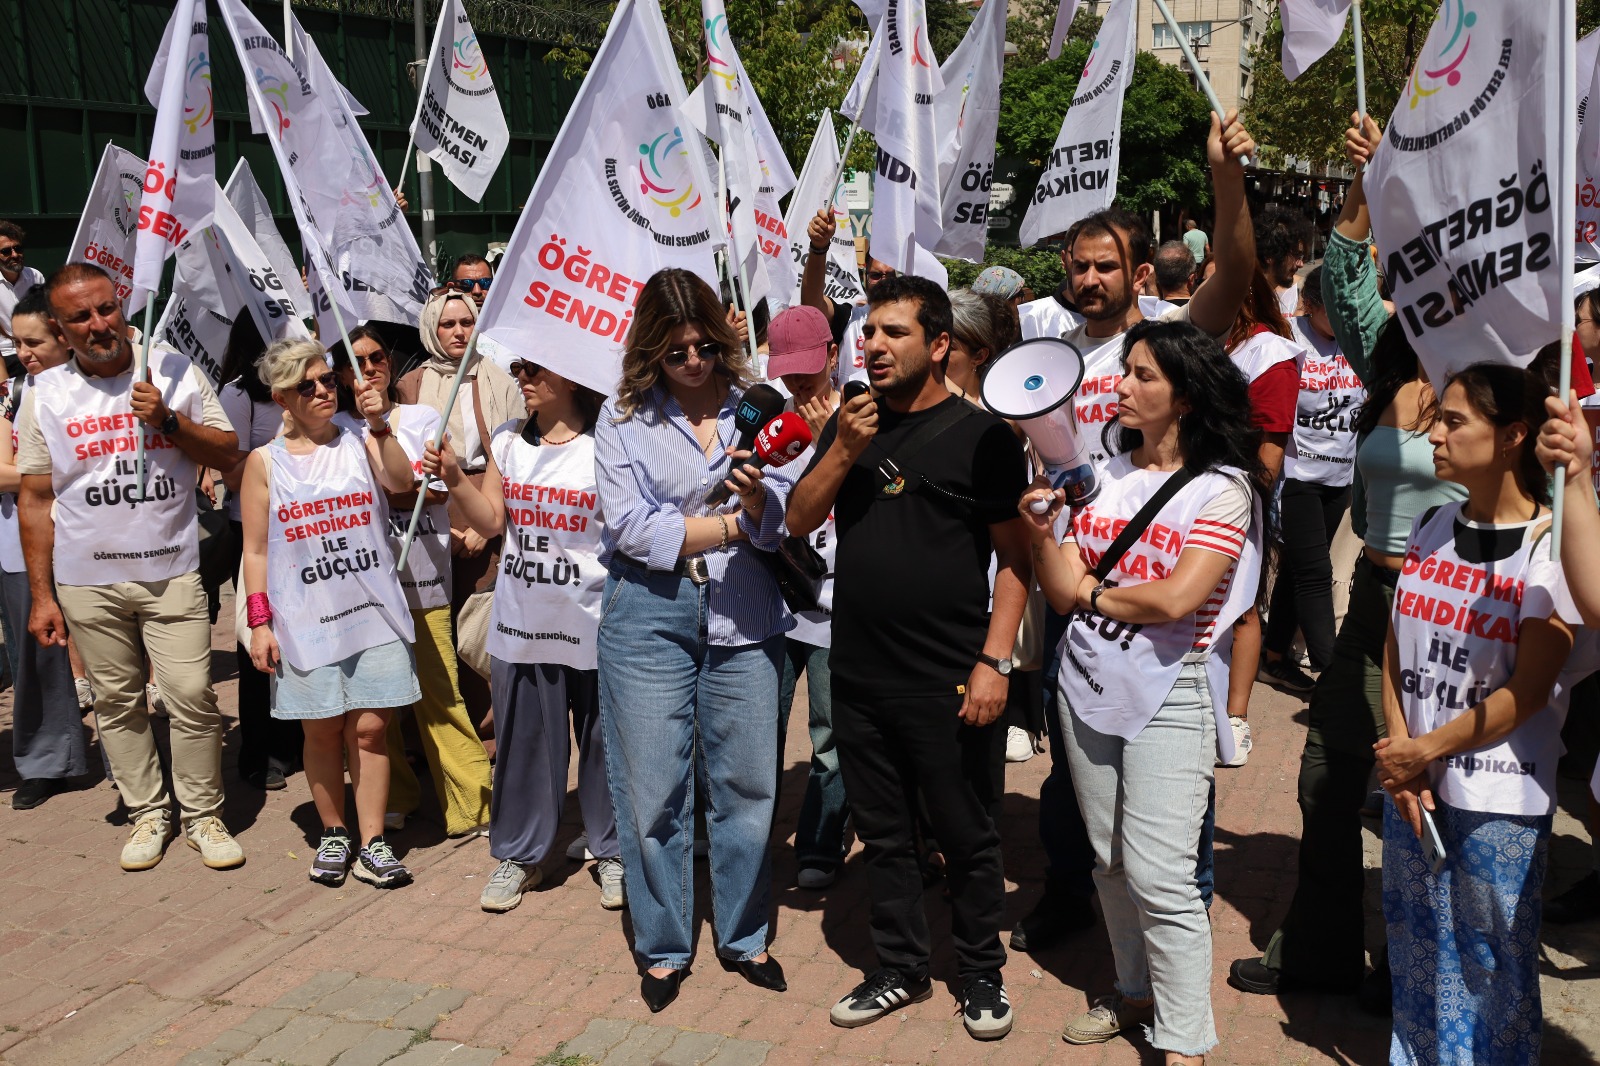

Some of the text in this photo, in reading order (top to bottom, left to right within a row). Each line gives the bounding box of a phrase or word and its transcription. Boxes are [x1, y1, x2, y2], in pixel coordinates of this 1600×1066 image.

[605, 158, 617, 179] ÖZEL
[607, 179, 631, 214] SEKTÖR
[524, 281, 634, 346] SENDİ
[277, 491, 374, 524] ÖĞRETMEN
[284, 510, 371, 543] SENDİKASI
[518, 527, 550, 553] İLE
[93, 544, 181, 561] ÖĞRETMEN SENDİKASI
[320, 536, 349, 554] İLE
[301, 547, 380, 585] GÜÇLÜ!
[504, 553, 582, 588] GÜÇLÜ!
[496, 621, 581, 645] ÖĞRETMEN SENDİKASI
[1427, 631, 1470, 674] İLE
